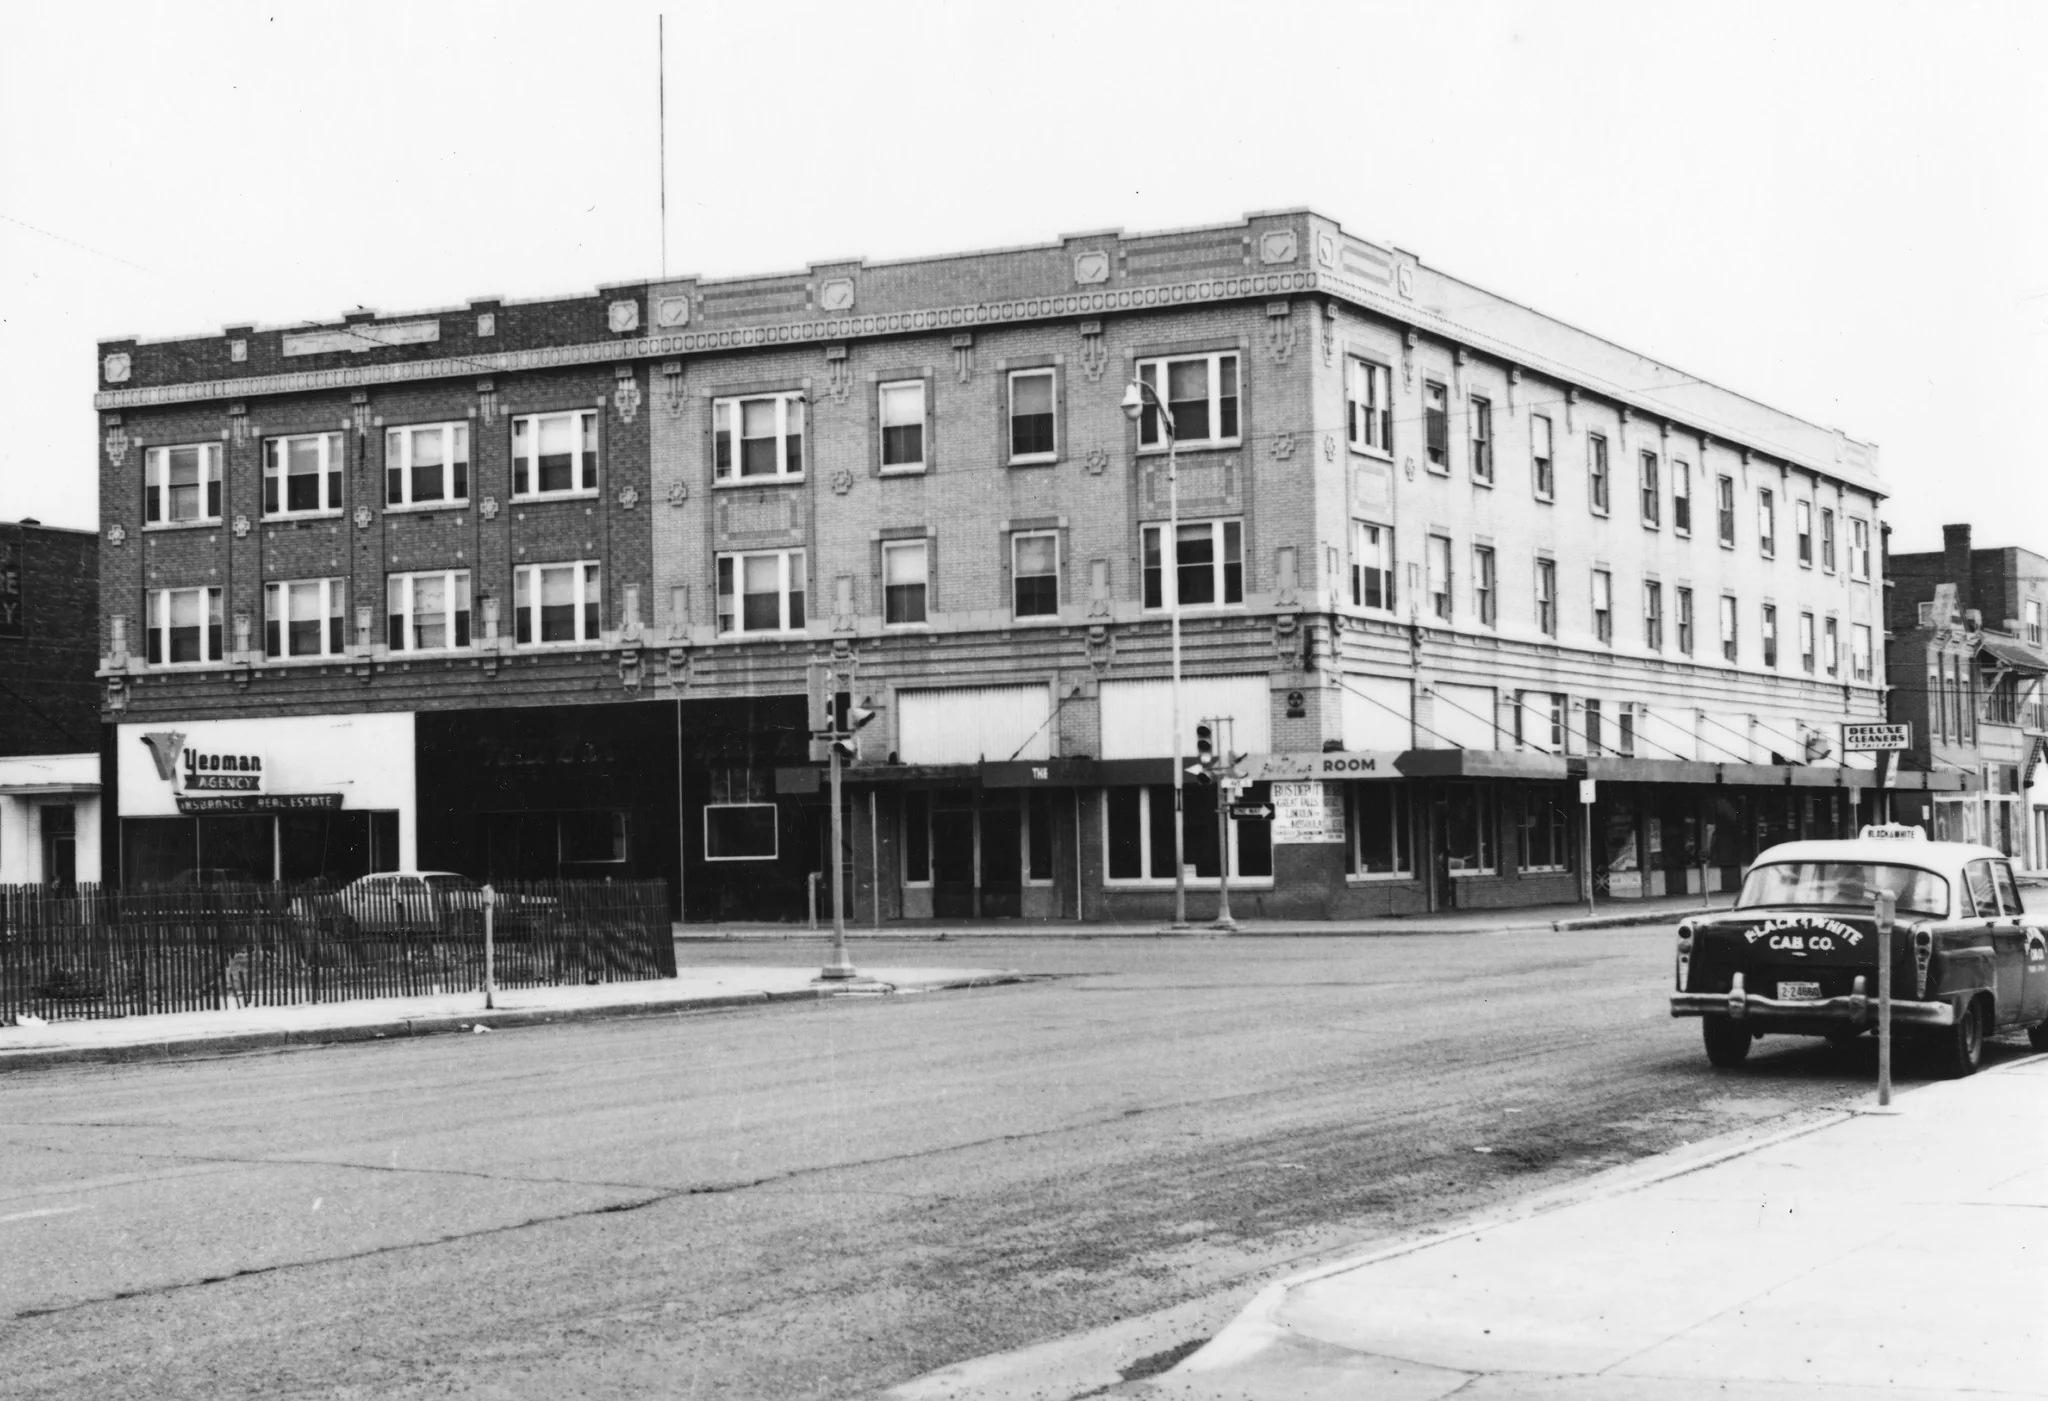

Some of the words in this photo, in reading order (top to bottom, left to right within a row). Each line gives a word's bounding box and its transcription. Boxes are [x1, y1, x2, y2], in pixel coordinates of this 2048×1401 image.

[1849, 726, 1903, 735] DELUXE
[1848, 734, 1905, 743] CLEANERS
[184, 748, 262, 778] Yeoman
[1323, 759, 1375, 772] ROOM
[1032, 767, 1048, 780] THE
[198, 776, 254, 789] AGENCY
[181, 798, 245, 810] INSURANCE
[258, 798, 285, 808] REAL
[290, 796, 333, 807] ESTATE
[1744, 916, 1798, 944] BLACK
[1811, 917, 1864, 946] WHITE
[1769, 935, 1804, 950] CAB
[1808, 935, 1835, 951] CO.
